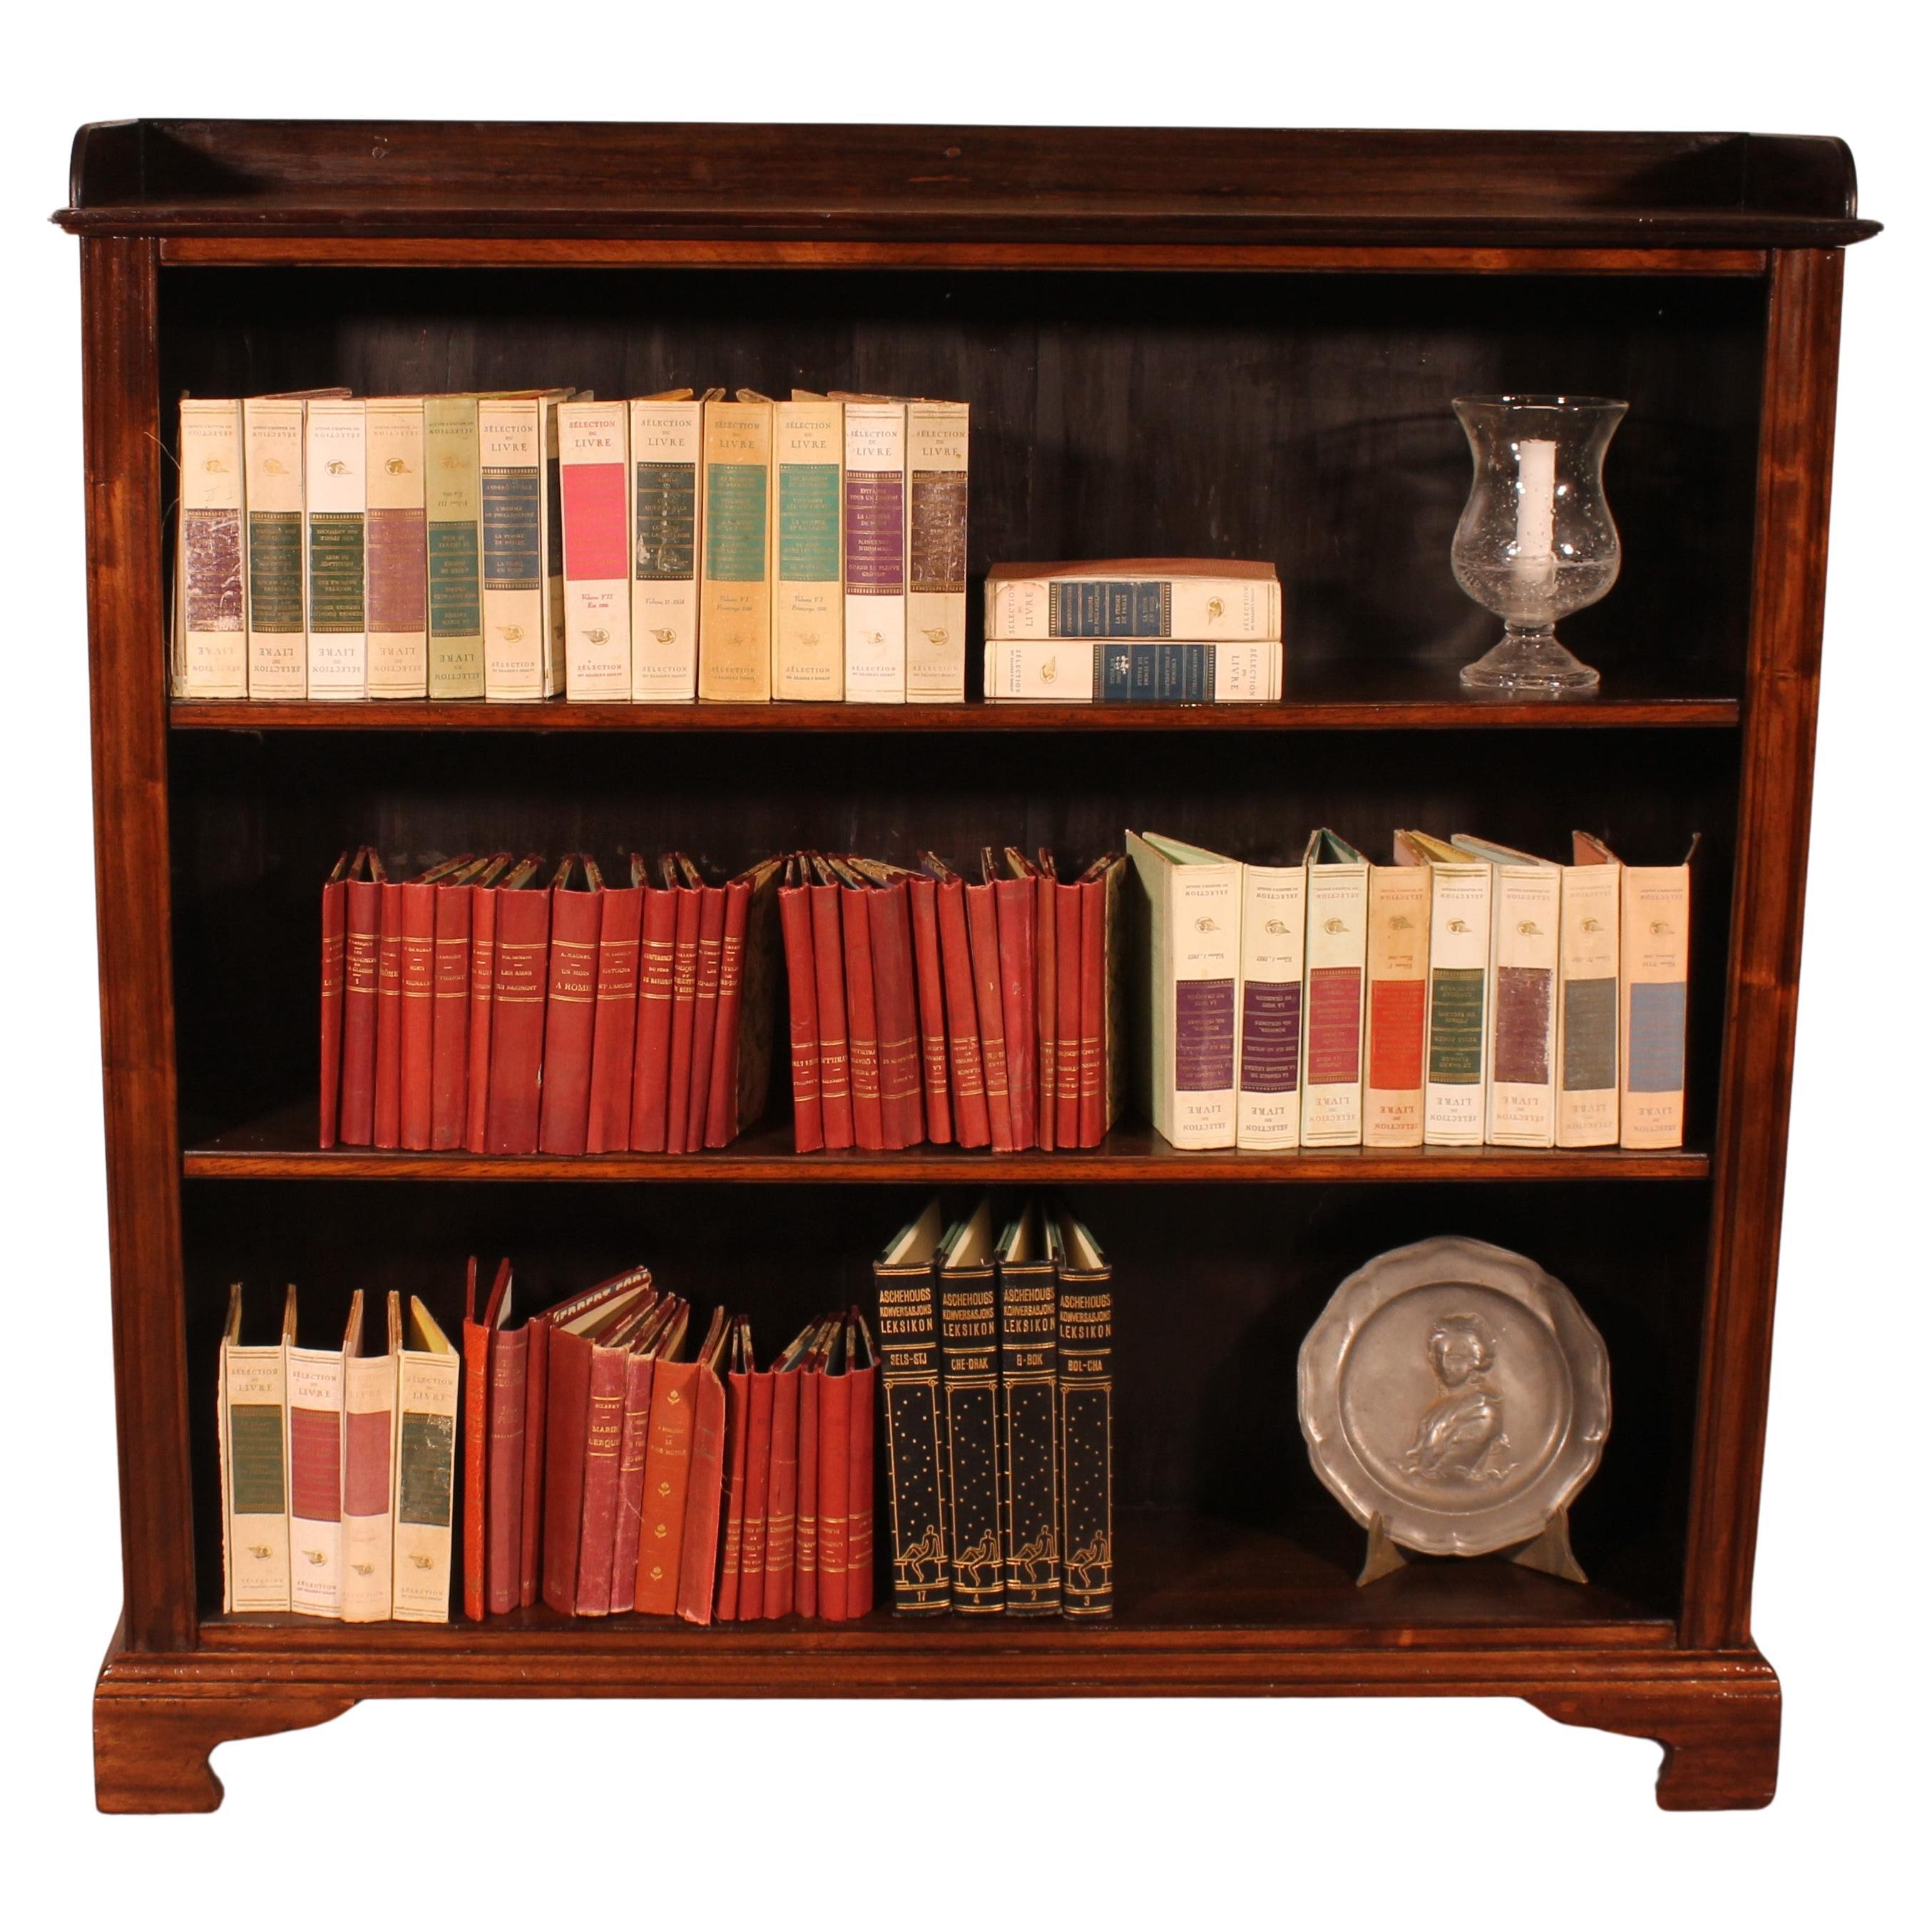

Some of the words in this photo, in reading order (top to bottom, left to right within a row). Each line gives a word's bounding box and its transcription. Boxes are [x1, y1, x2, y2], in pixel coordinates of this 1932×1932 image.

[484, 424, 533, 434] SÉLECTION
[568, 420, 615, 429] SÉLECTION
[491, 443, 528, 451] LIVRE
[575, 438, 611, 448] LIVRE
[648, 438, 685, 446] LIVRE
[720, 439, 755, 449] LIVRE
[791, 439, 827, 449] LIVRE
[857, 447, 892, 456] LIVRE
[922, 447, 959, 456] LIVRE
[1025, 591, 1033, 627] LIVRE
[259, 648, 294, 656] LIVRE
[318, 648, 354, 656] LIVRE
[379, 647, 415, 655] LIVRE
[439, 653, 474, 663] LIVRE
[1230, 655, 1239, 690] LIVRE
[556, 981, 562, 990] A
[564, 983, 593, 992] ROME
[1314, 1096, 1350, 1106] LIVRE
[1436, 1097, 1471, 1105] LIVRE
[1502, 1096, 1539, 1105] LIVRE
[1186, 1104, 1222, 1113] LIVRE
[1250, 1106, 1284, 1115] LIVRE
[1379, 1105, 1414, 1114] LIVRE
[1572, 1103, 1607, 1113] LIVRE
[1637, 1106, 1672, 1115] LIVRE
[879, 1287, 931, 1304] ASCHEHOUGS
[942, 1290, 994, 1307] ASCHEHOUGS
[1003, 1286, 1056, 1303] ASCHEHOUGS
[1060, 1292, 1112, 1309] ASCHEHOUGS
[879, 1304, 932, 1319] KONVERSASJONS
[942, 1306, 995, 1320] KONVERSASJONS
[1003, 1302, 1056, 1317] KONVERSASJONS
[1060, 1309, 1112, 1323] KONVERSASJONS
[880, 1318, 934, 1334] LEKSIKON
[943, 1320, 996, 1337] LEKSIKON
[1003, 1317, 1056, 1334] LEKSIKON
[1060, 1324, 1113, 1339] LEKSIKON
[890, 1352, 928, 1366] SELS-STJ
[951, 1356, 989, 1371] CHE-DRAK
[1068, 1358, 1103, 1373] BOL-CHA
[238, 1384, 274, 1392] LIVRE
[298, 1387, 332, 1399] LIVRE
[412, 1391, 447, 1402] LIVRE
[592, 1426, 619, 1434] MARIE
[917, 1590, 927, 1603] 17
[973, 1593, 981, 1604] 4
[1083, 1595, 1090, 1607] 3
